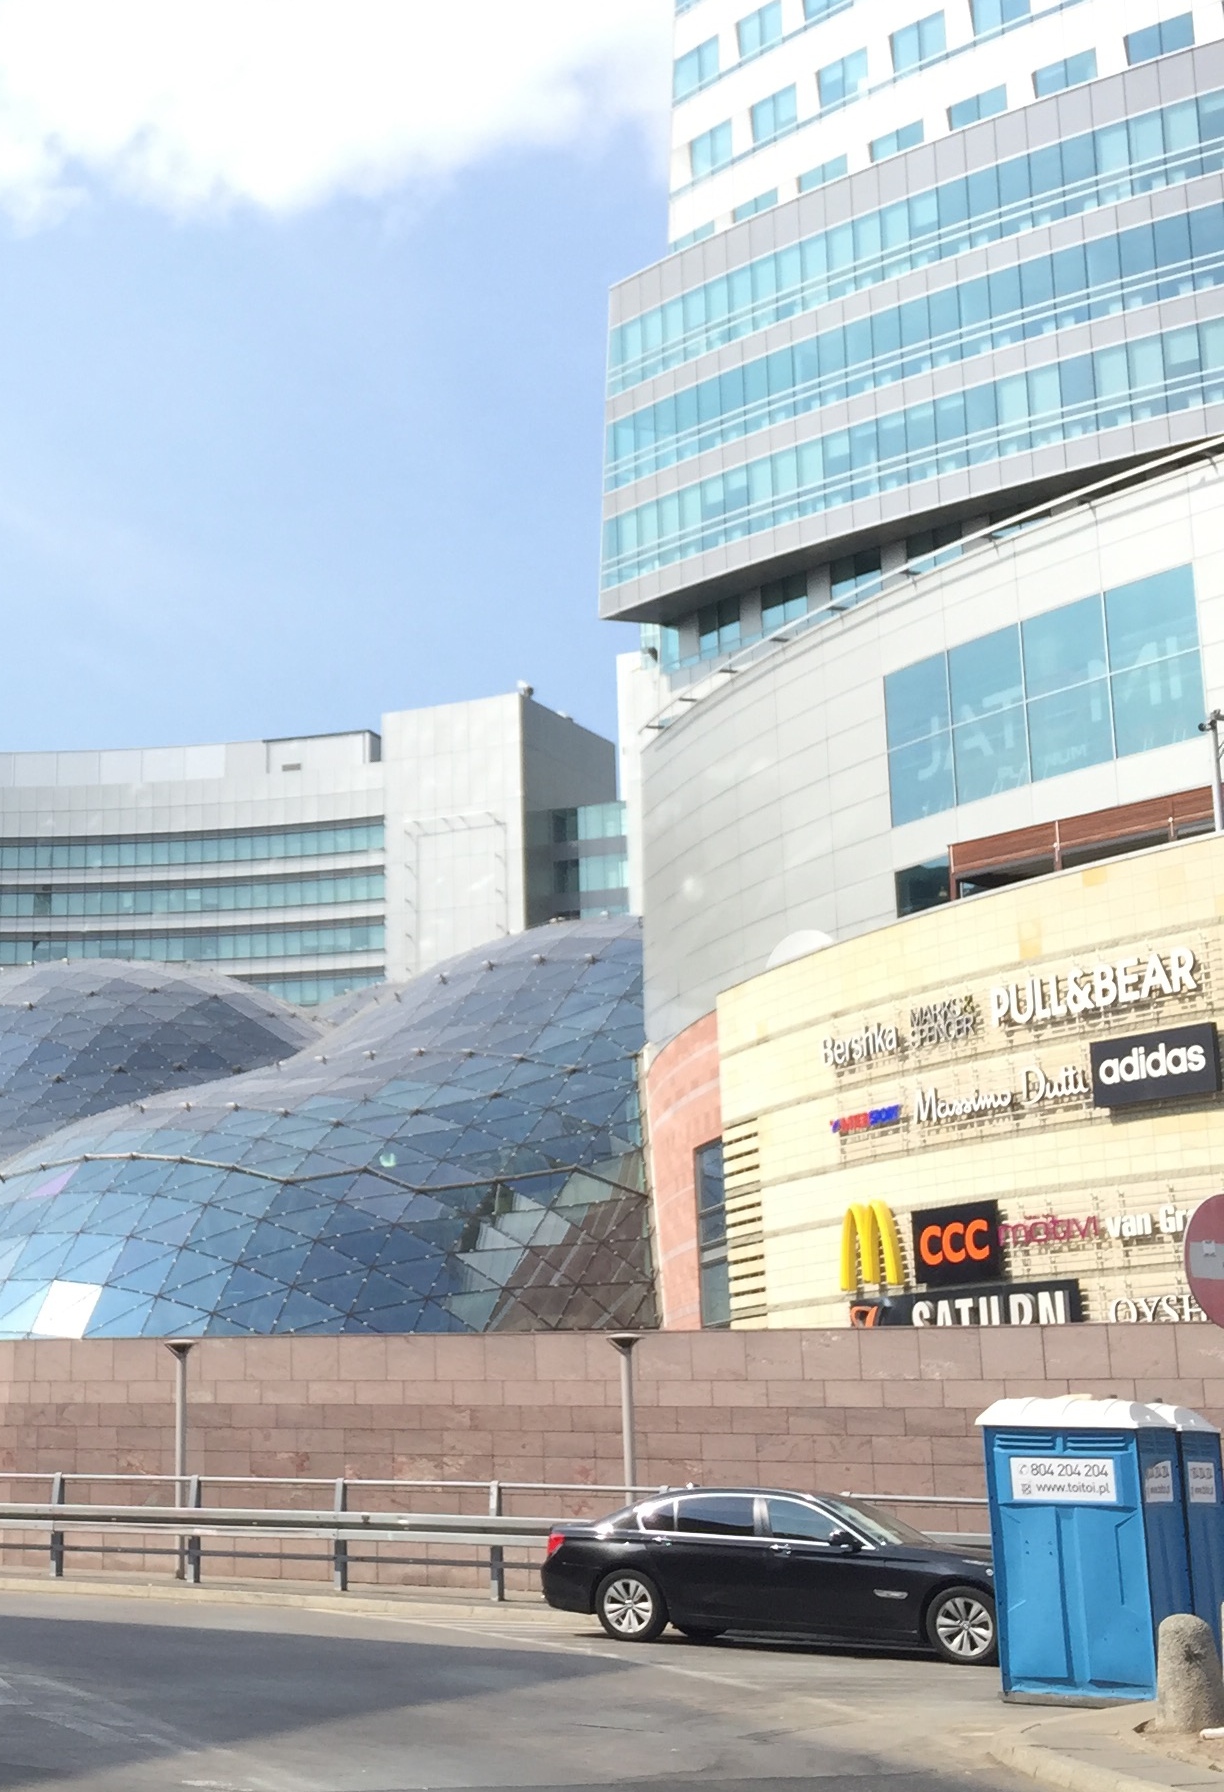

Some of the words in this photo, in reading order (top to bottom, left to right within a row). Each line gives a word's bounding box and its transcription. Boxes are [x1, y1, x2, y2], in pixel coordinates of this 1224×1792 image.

[989, 946, 1198, 1028] PULL&BEAR
[819, 1022, 899, 1068] Bershka
[908, 1015, 977, 1050] SPENCER
[1098, 1042, 1207, 1085] adidas
[914, 1085, 1012, 1125] Massimo
[1021, 1063, 1089, 1105] Dutti
[919, 1218, 990, 1265] CCC
[1106, 1212, 1152, 1238] van
[1109, 1294, 1209, 1323] OYSH
[1030, 1463, 1054, 1476] 804
[1058, 1464, 1081, 1477] 204
[1084, 1464, 1109, 1478] 204
[1036, 1481, 1110, 1496] www.toitoi.pl
